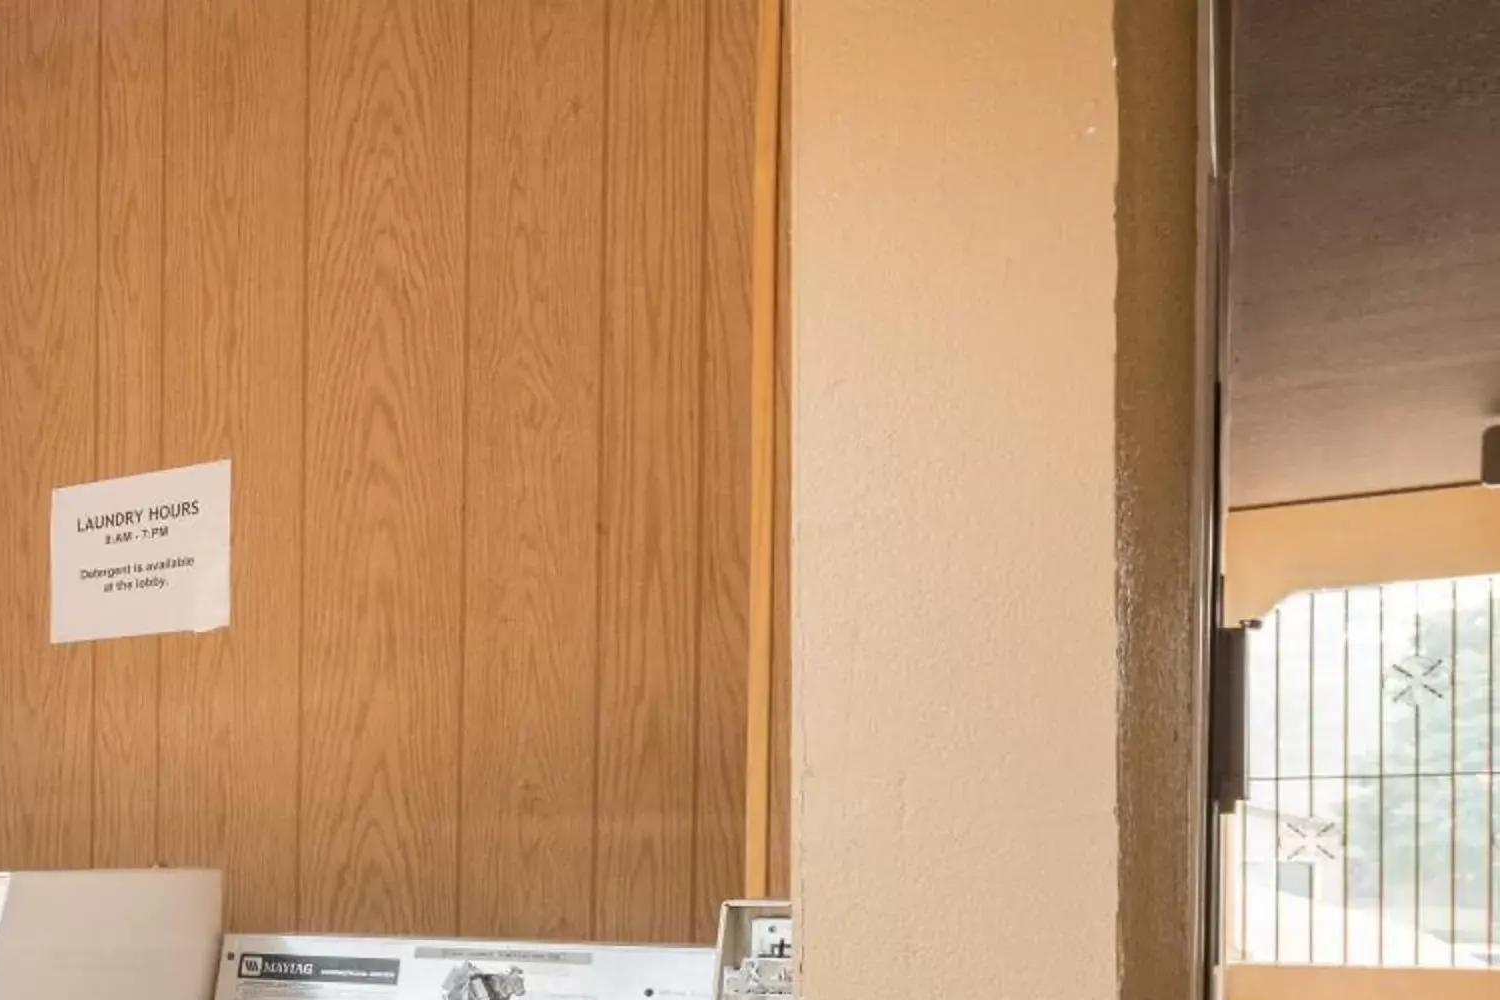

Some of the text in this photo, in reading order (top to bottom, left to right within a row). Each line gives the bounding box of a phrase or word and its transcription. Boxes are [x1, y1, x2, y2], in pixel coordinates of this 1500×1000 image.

[77, 499, 199, 532] LAUNDRY HOURS
[151, 526, 169, 538] PM
[80, 556, 195, 579] Detergent is available
[103, 582, 113, 592] at
[115, 579, 133, 591] the
[264, 961, 314, 975] MAYTAG
